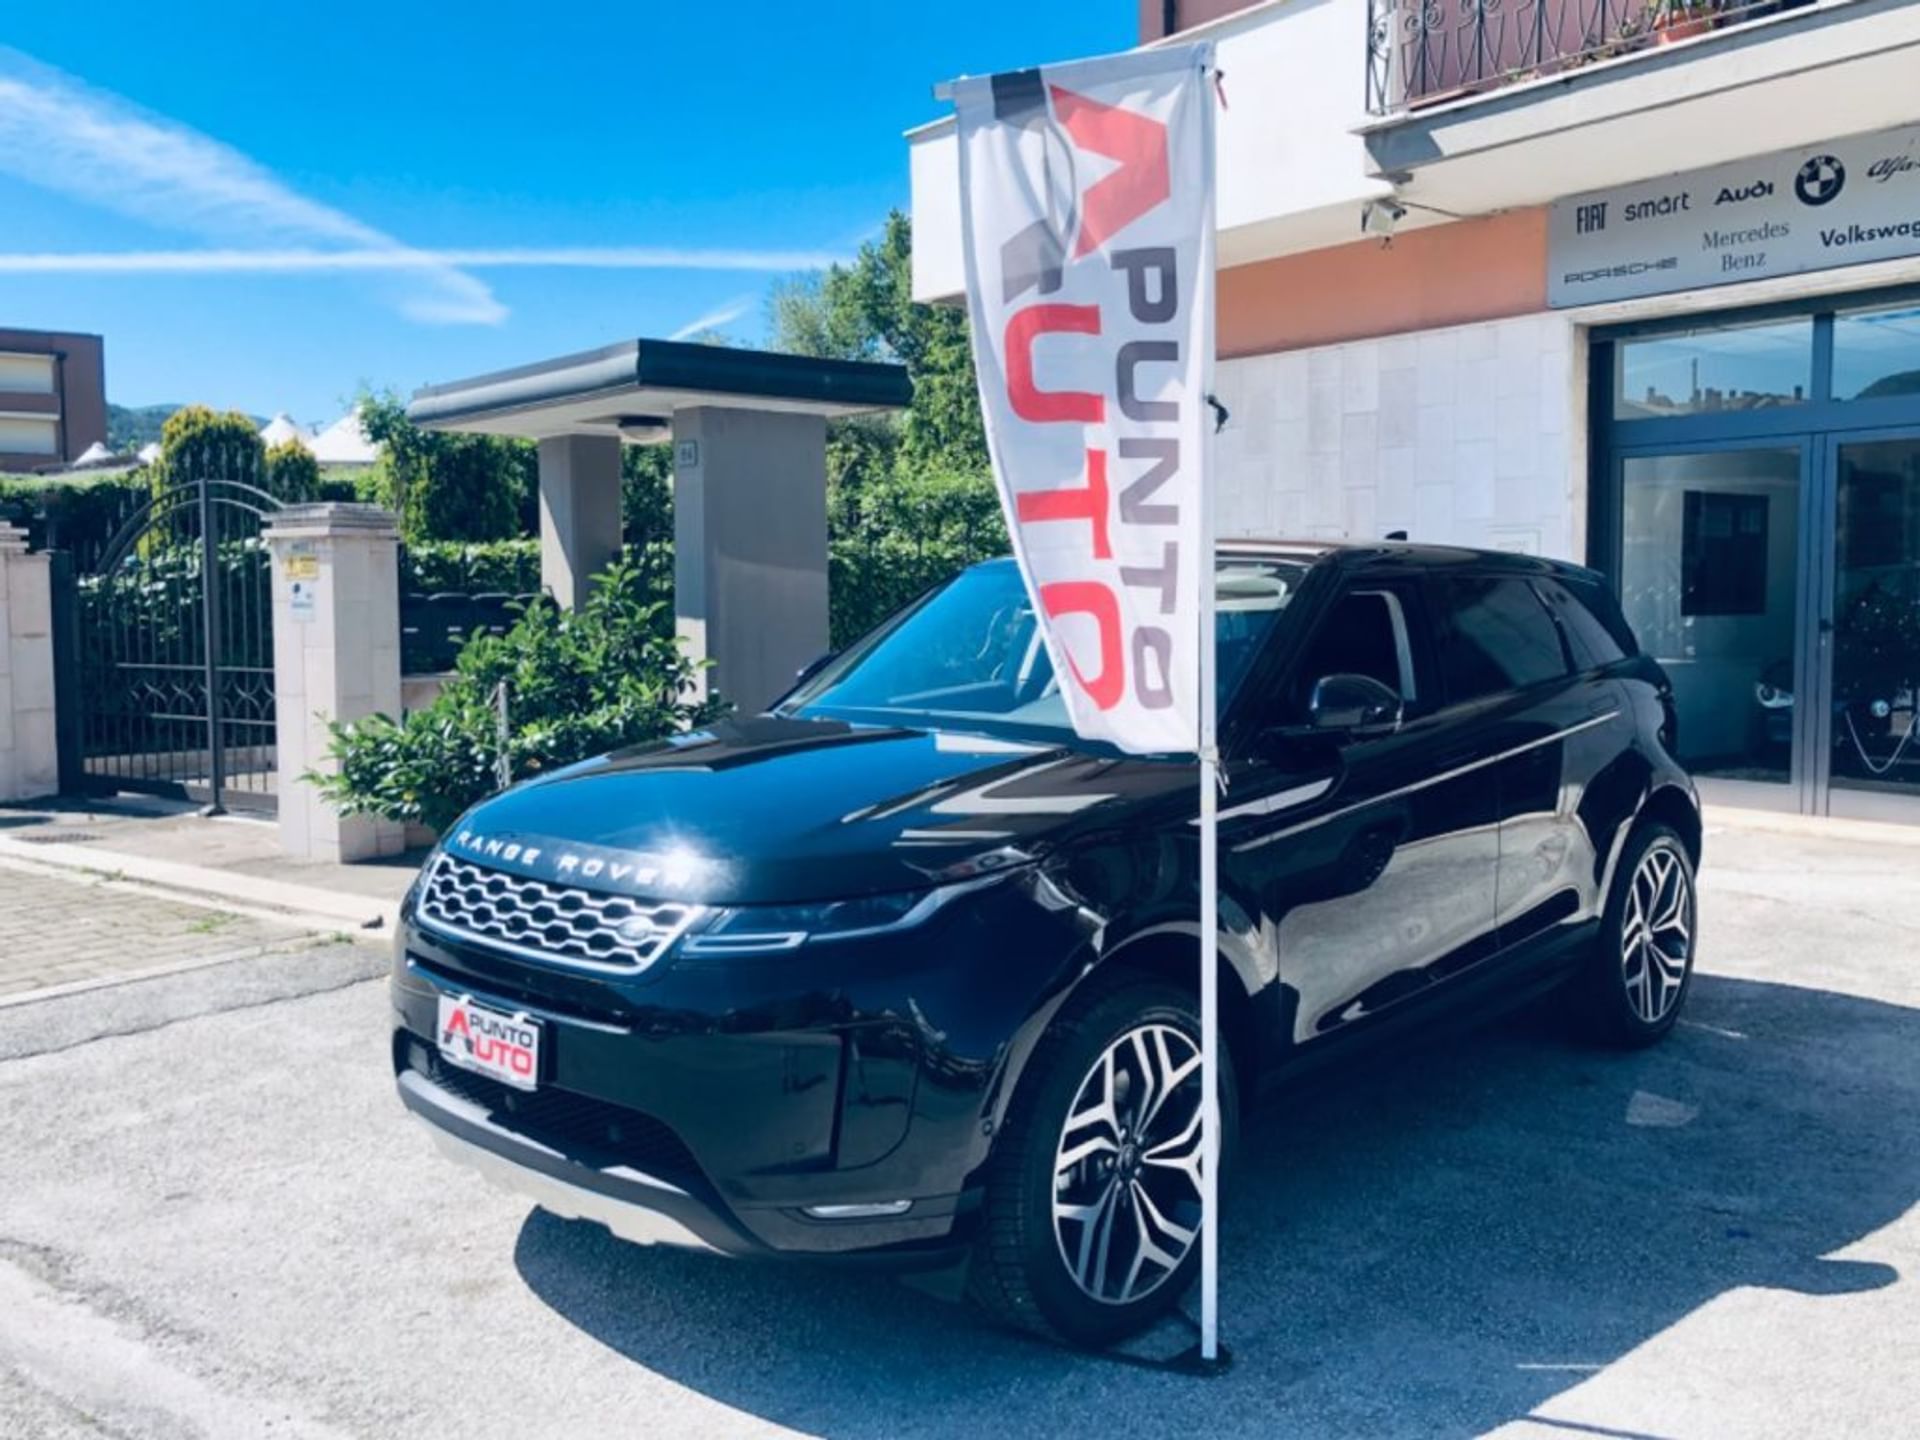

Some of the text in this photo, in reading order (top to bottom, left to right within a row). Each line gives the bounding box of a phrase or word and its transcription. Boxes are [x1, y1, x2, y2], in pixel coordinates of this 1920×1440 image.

[1576, 202, 1609, 235] FIAT
[1624, 192, 1690, 222] smart
[1714, 181, 1774, 206] Audi
[1702, 222, 1790, 250] Mercedes
[1564, 256, 1678, 284] PORSCHE
[1721, 252, 1767, 273] Benz
[456, 830, 691, 889] RANGE ROVER
